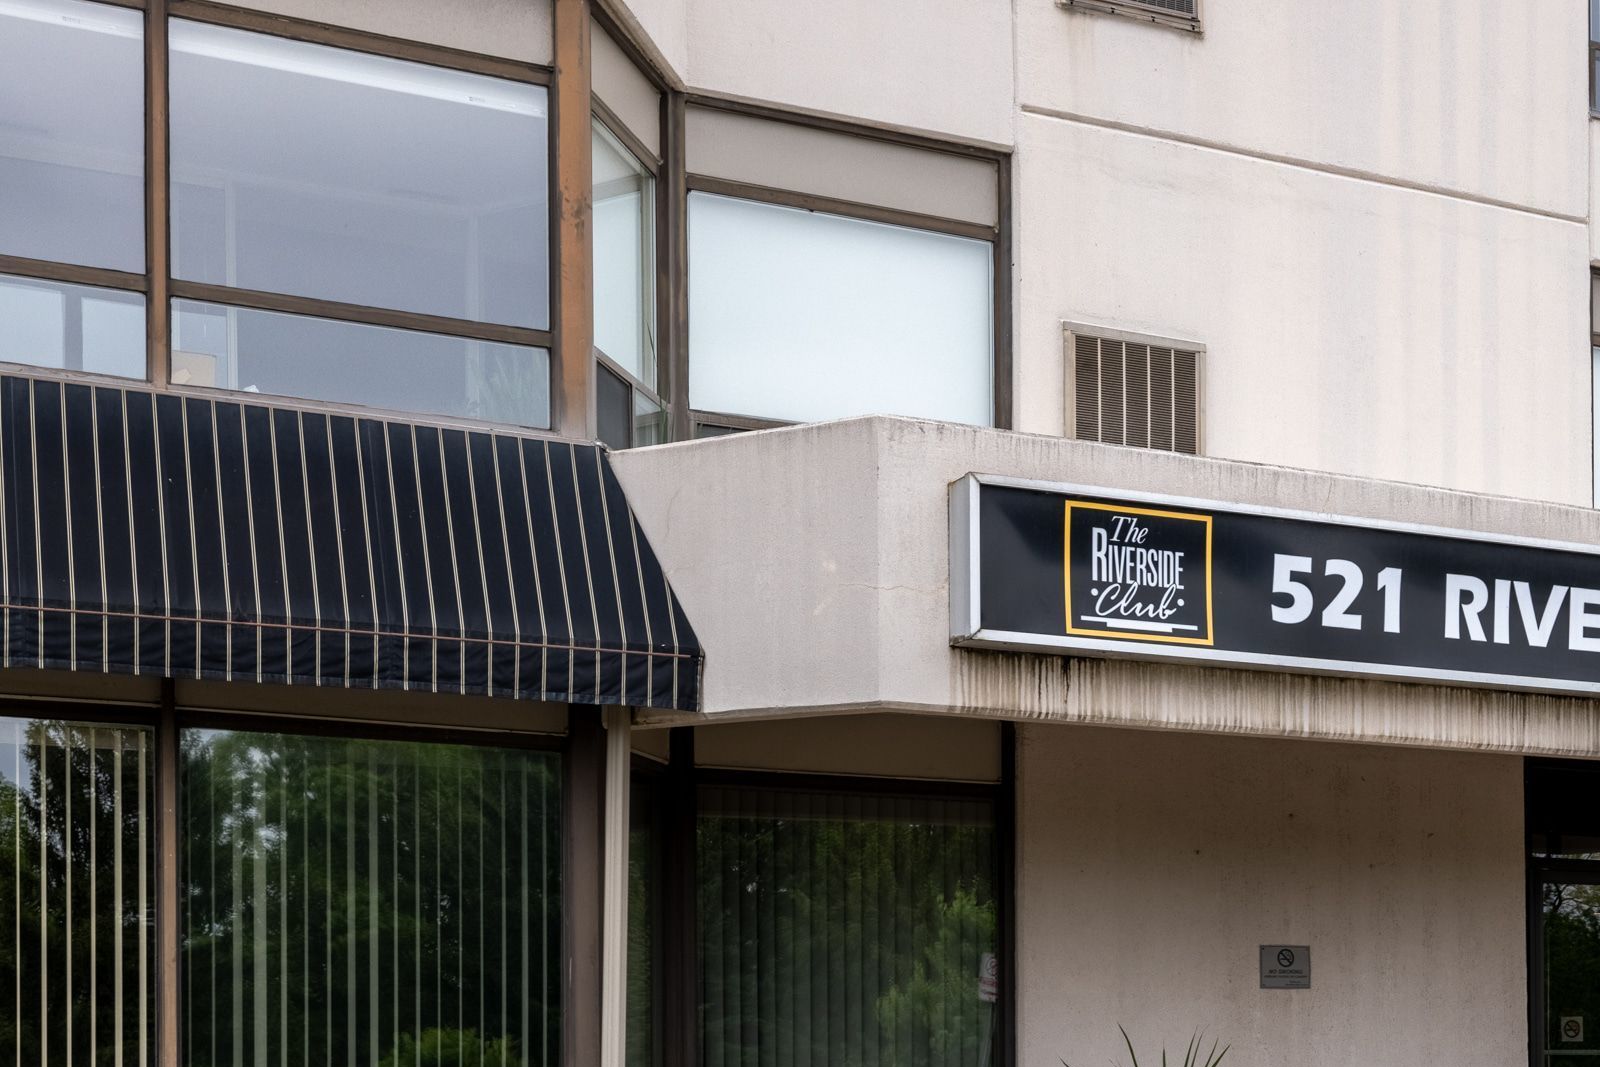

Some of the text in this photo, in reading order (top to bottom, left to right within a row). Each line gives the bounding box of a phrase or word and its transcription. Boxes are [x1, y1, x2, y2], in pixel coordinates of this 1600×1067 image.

[1109, 515, 1149, 544] The
[1091, 526, 1185, 590] RIVERSIDE
[1095, 581, 1177, 620] Club
[1270, 553, 1403, 634] 521
